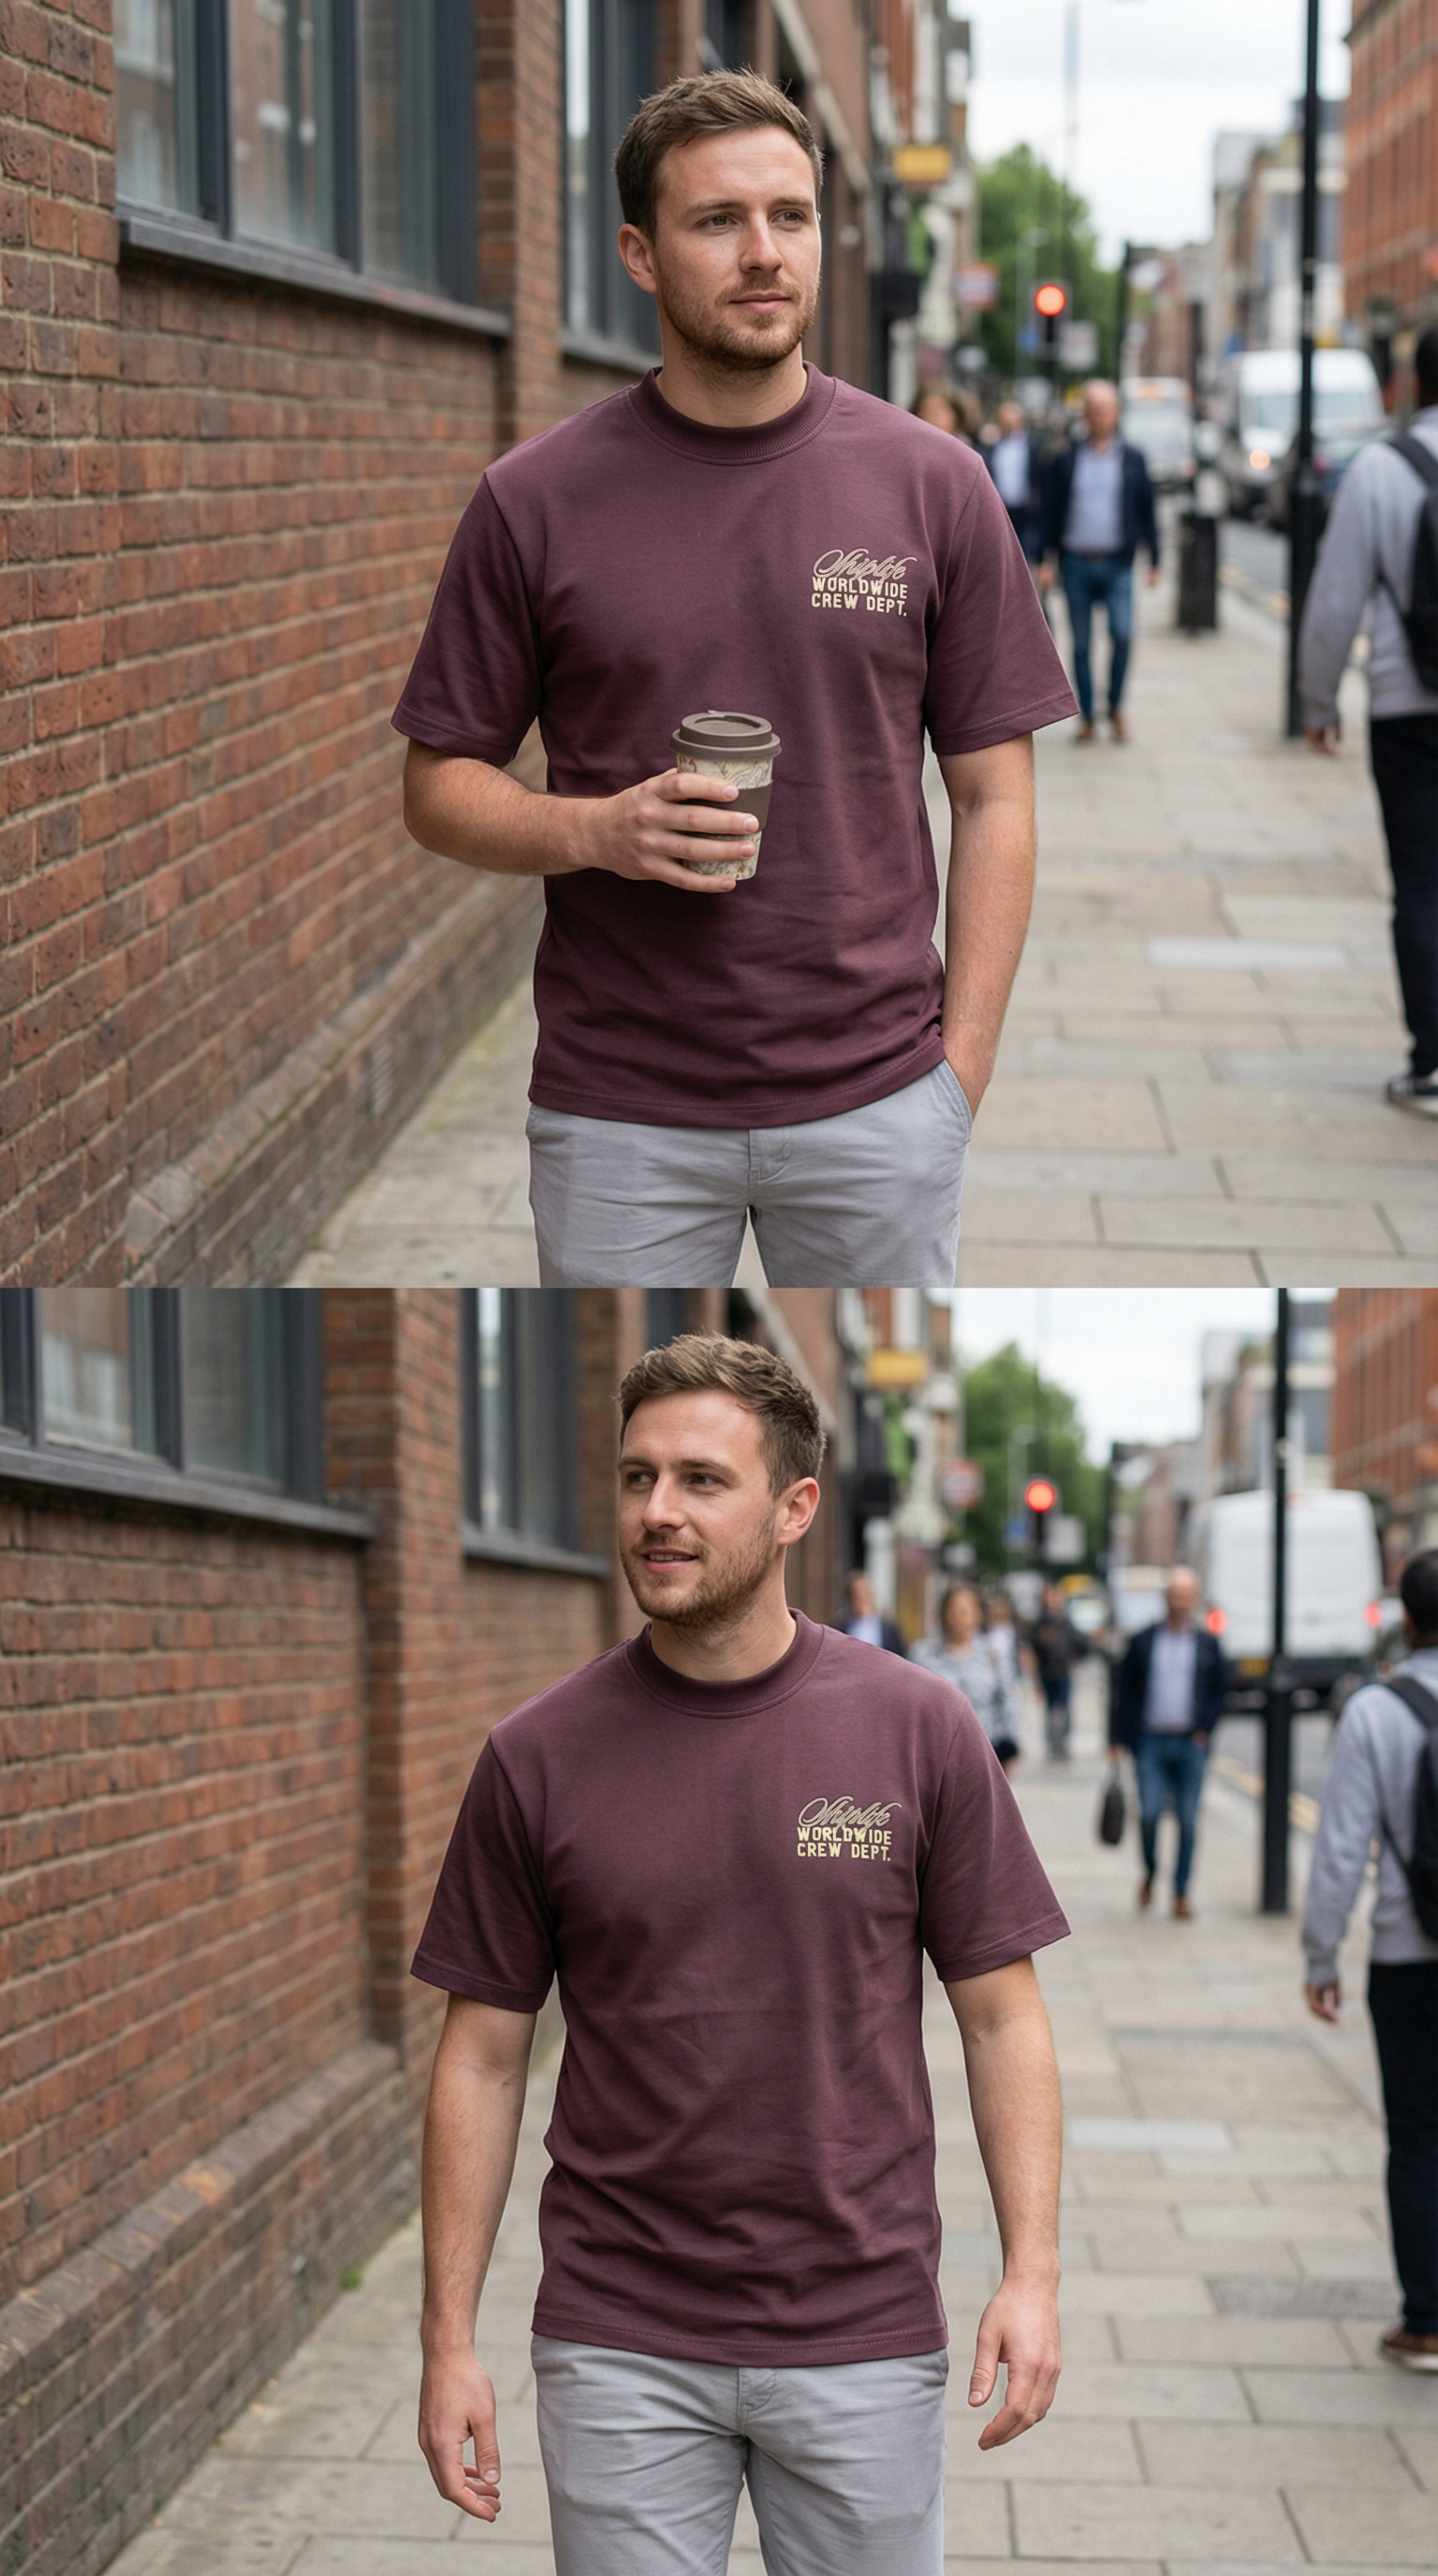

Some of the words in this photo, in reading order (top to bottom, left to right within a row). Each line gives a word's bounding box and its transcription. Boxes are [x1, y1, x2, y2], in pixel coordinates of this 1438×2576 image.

[812, 577, 908, 599] WORLDWIDE
[811, 593, 858, 609] CREW
[866, 596, 907, 617] DEPT.
[797, 1826, 892, 1845] WORLDWIDE
[797, 1842, 842, 1857] CREW
[851, 1843, 891, 1862] DEPT.
